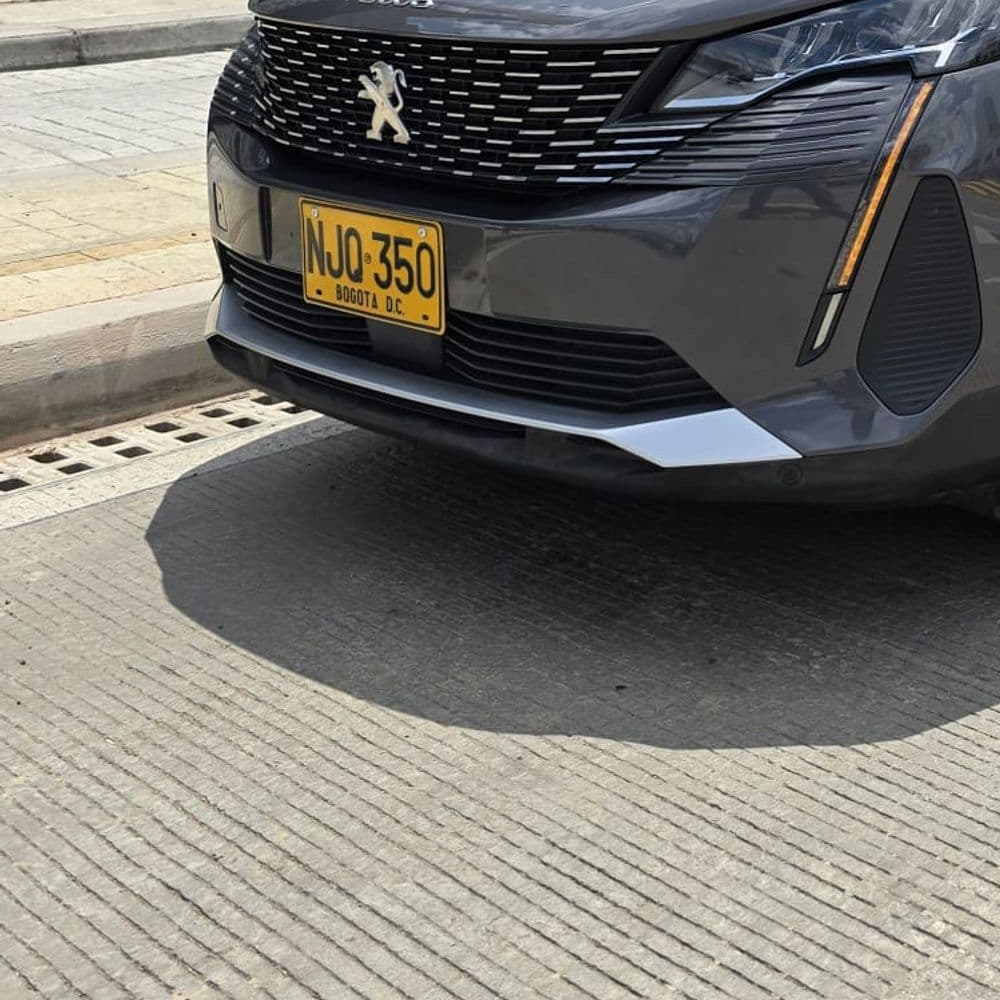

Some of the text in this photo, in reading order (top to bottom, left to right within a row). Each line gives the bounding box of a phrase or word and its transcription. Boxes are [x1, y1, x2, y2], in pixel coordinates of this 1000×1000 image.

[305, 217, 436, 299] NJQ 350
[335, 283, 406, 317] BOGOTA D.C.
